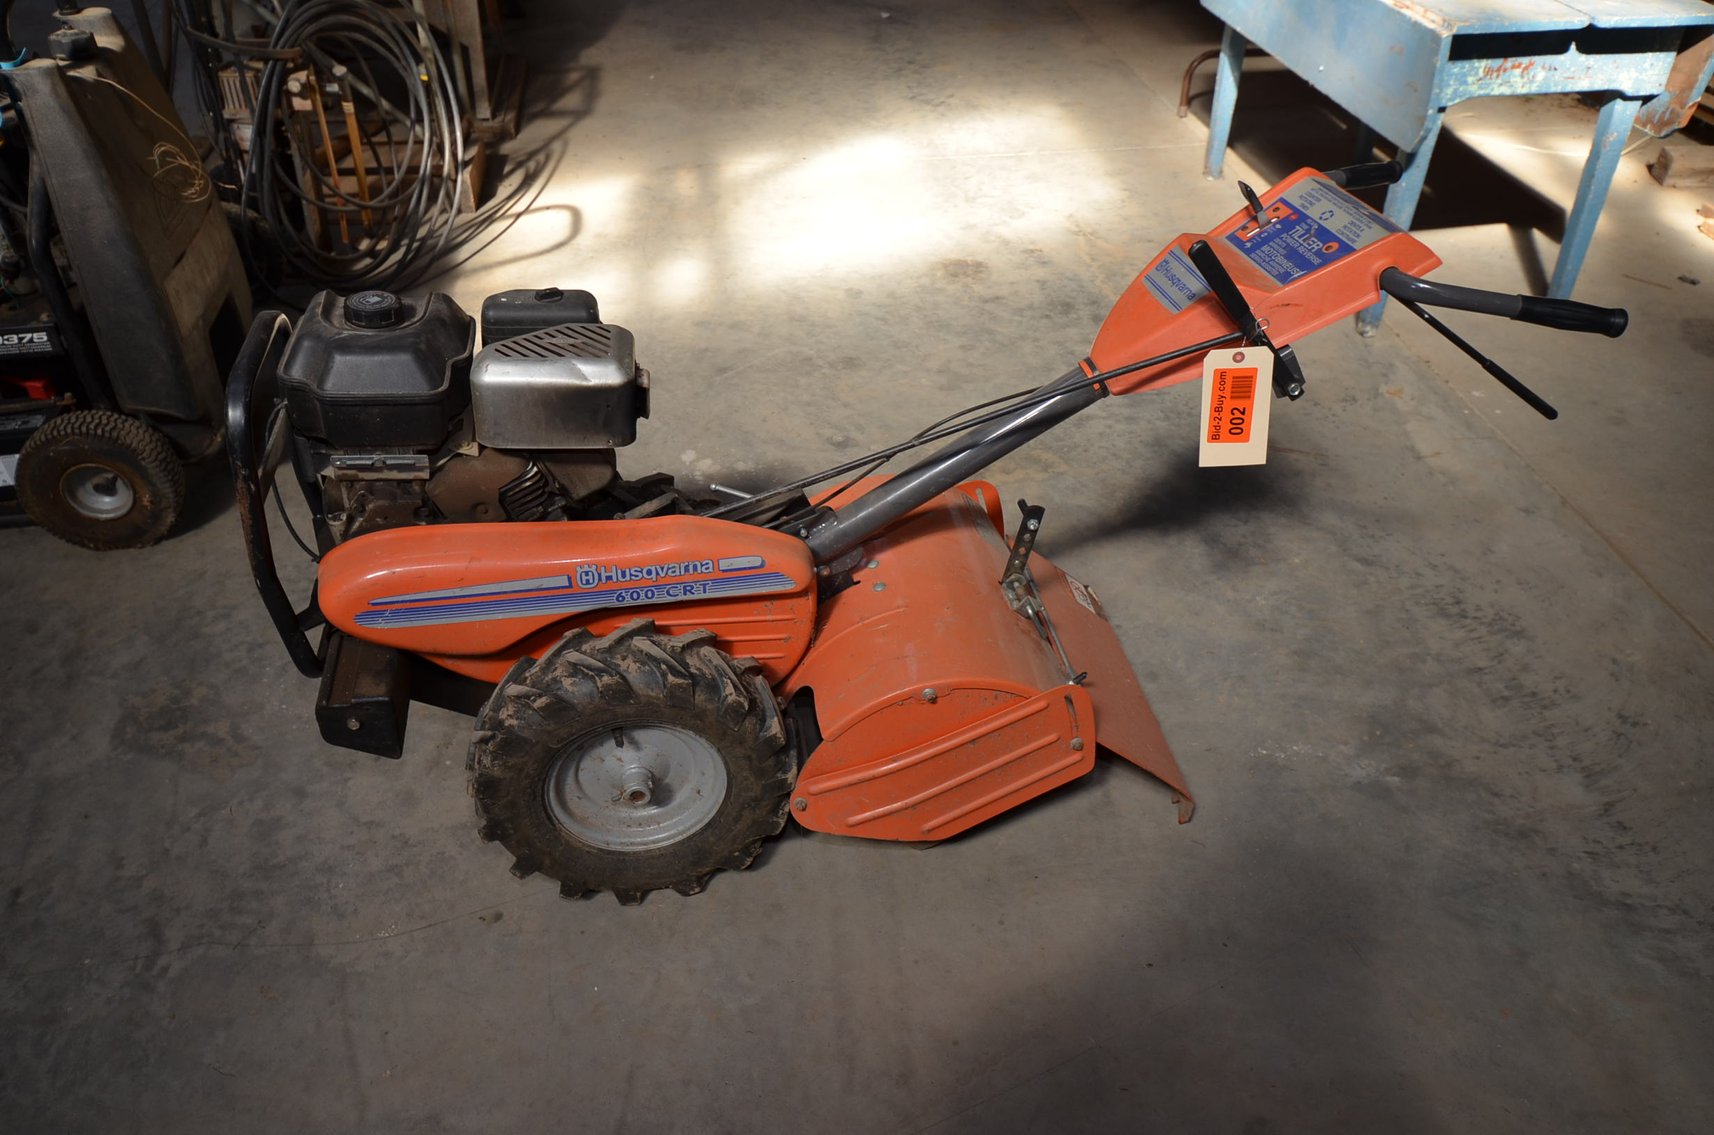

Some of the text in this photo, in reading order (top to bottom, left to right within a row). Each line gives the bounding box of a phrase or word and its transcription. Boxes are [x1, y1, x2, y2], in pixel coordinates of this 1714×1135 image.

[1279, 232, 1300, 248] POWER
[1295, 245, 1323, 265] REVERSE
[1286, 225, 1325, 252] TILLER
[1161, 265, 1196, 301] Husqvarna
[1211, 371, 1227, 440] Bid-2-Buy.com
[1228, 407, 1246, 436] 002
[600, 559, 714, 583] Husqvarna
[615, 582, 710, 603] 600 CRT
